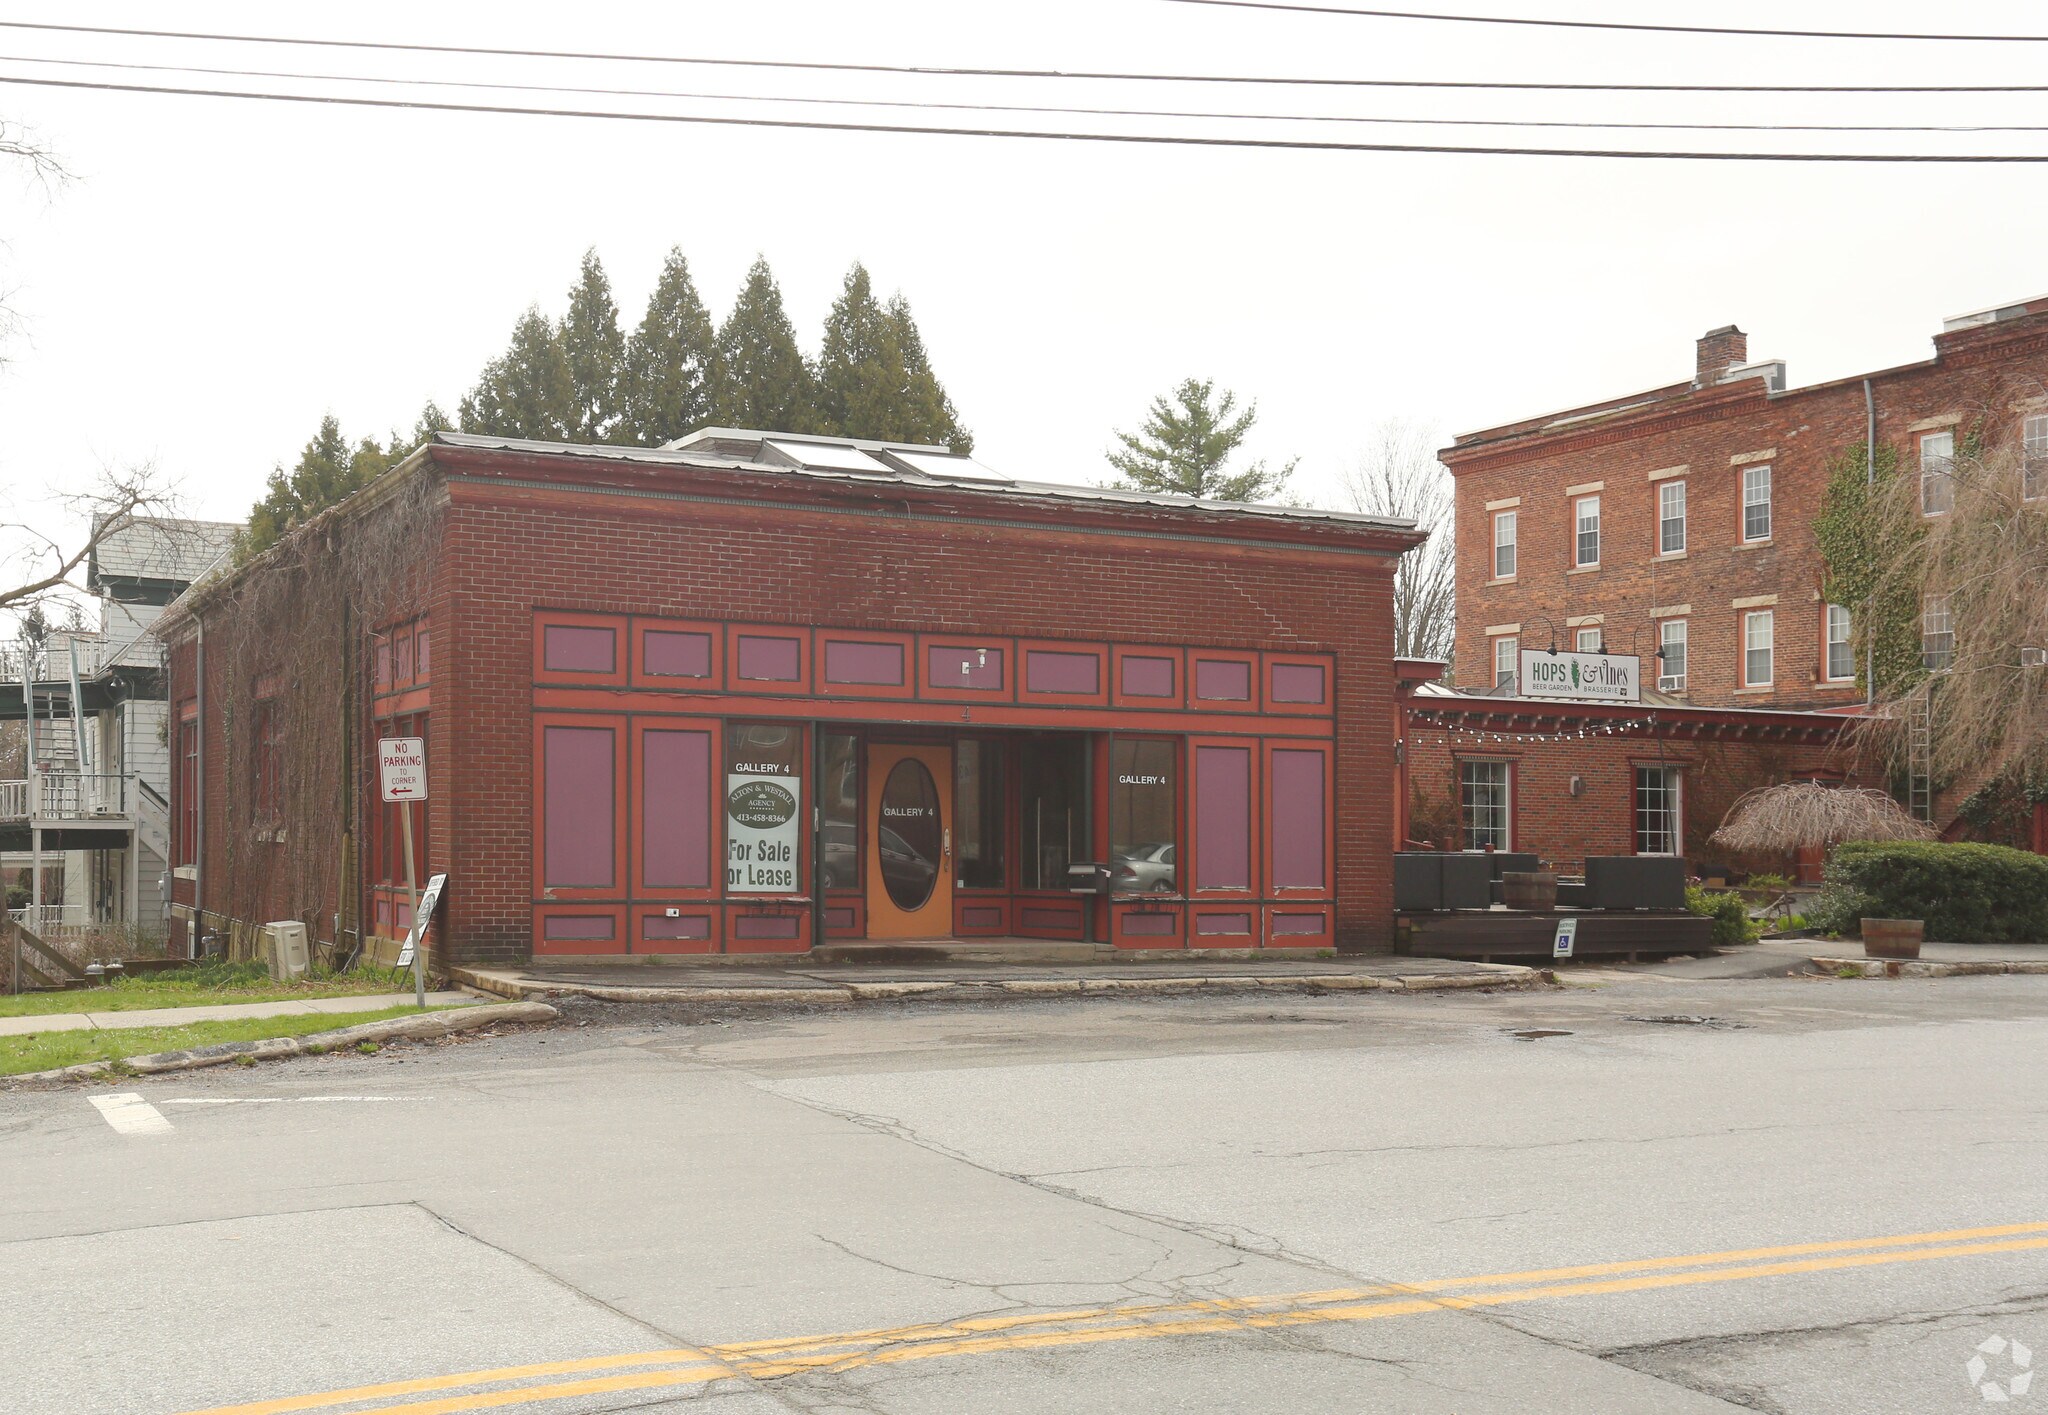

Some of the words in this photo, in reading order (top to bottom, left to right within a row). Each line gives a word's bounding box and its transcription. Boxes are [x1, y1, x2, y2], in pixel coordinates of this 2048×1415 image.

[1533, 662, 1566, 682] HOPS
[1583, 664, 1598, 683] &
[961, 705, 970, 719] 4
[395, 743, 408, 754] NO
[384, 756, 421, 767] PARKING
[400, 768, 407, 776] TO
[735, 763, 779, 773] GALLERY
[784, 765, 790, 773] 4
[392, 777, 416, 785] CORNER
[1119, 775, 1158, 784] GALLERY
[1160, 776, 1166, 784] 4
[731, 786, 753, 804] ALTON
[765, 785, 793, 806] WESTALL
[884, 808, 924, 816] GALLERY
[928, 808, 933, 816] 4
[729, 839, 752, 860] For
[758, 840, 790, 862] Sale
[728, 868, 742, 885] or
[748, 864, 792, 886] Lease
